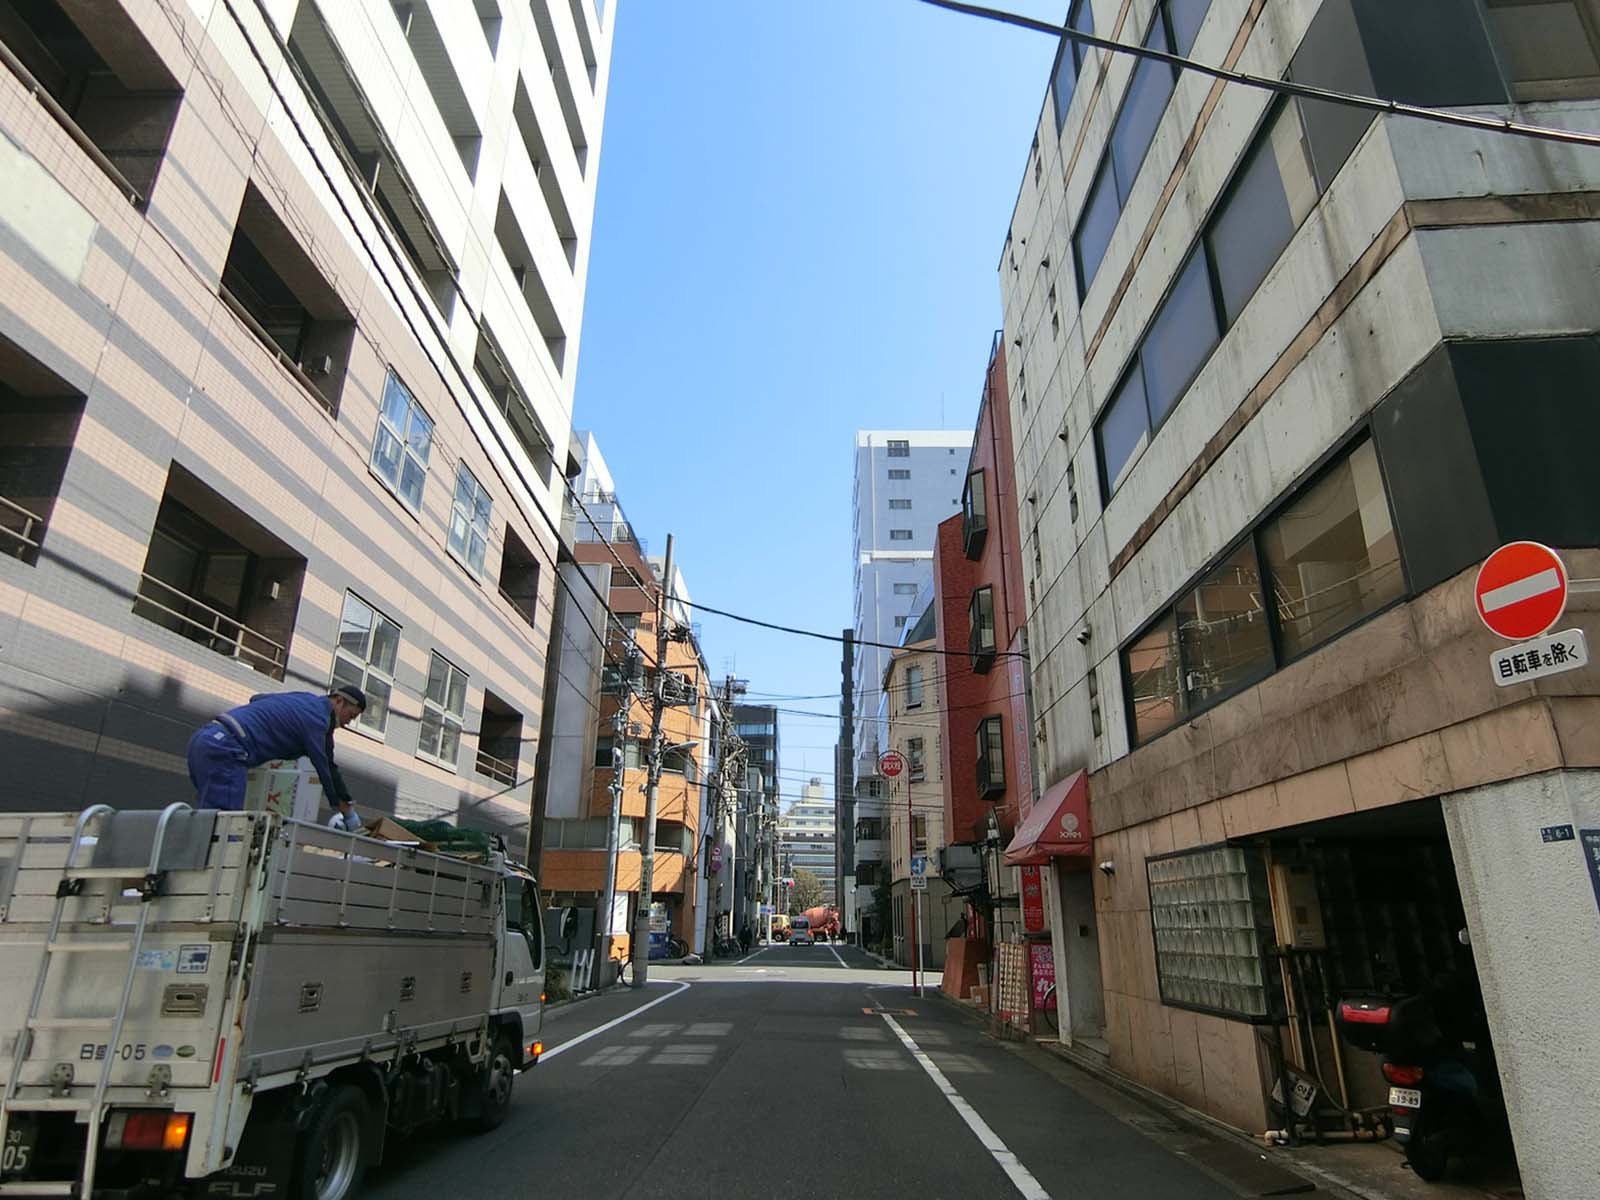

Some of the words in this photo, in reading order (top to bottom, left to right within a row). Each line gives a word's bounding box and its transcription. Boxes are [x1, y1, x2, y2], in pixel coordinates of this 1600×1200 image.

[1498, 642, 1579, 679] 自転車を除く
[2, 1145, 31, 1170] 05
